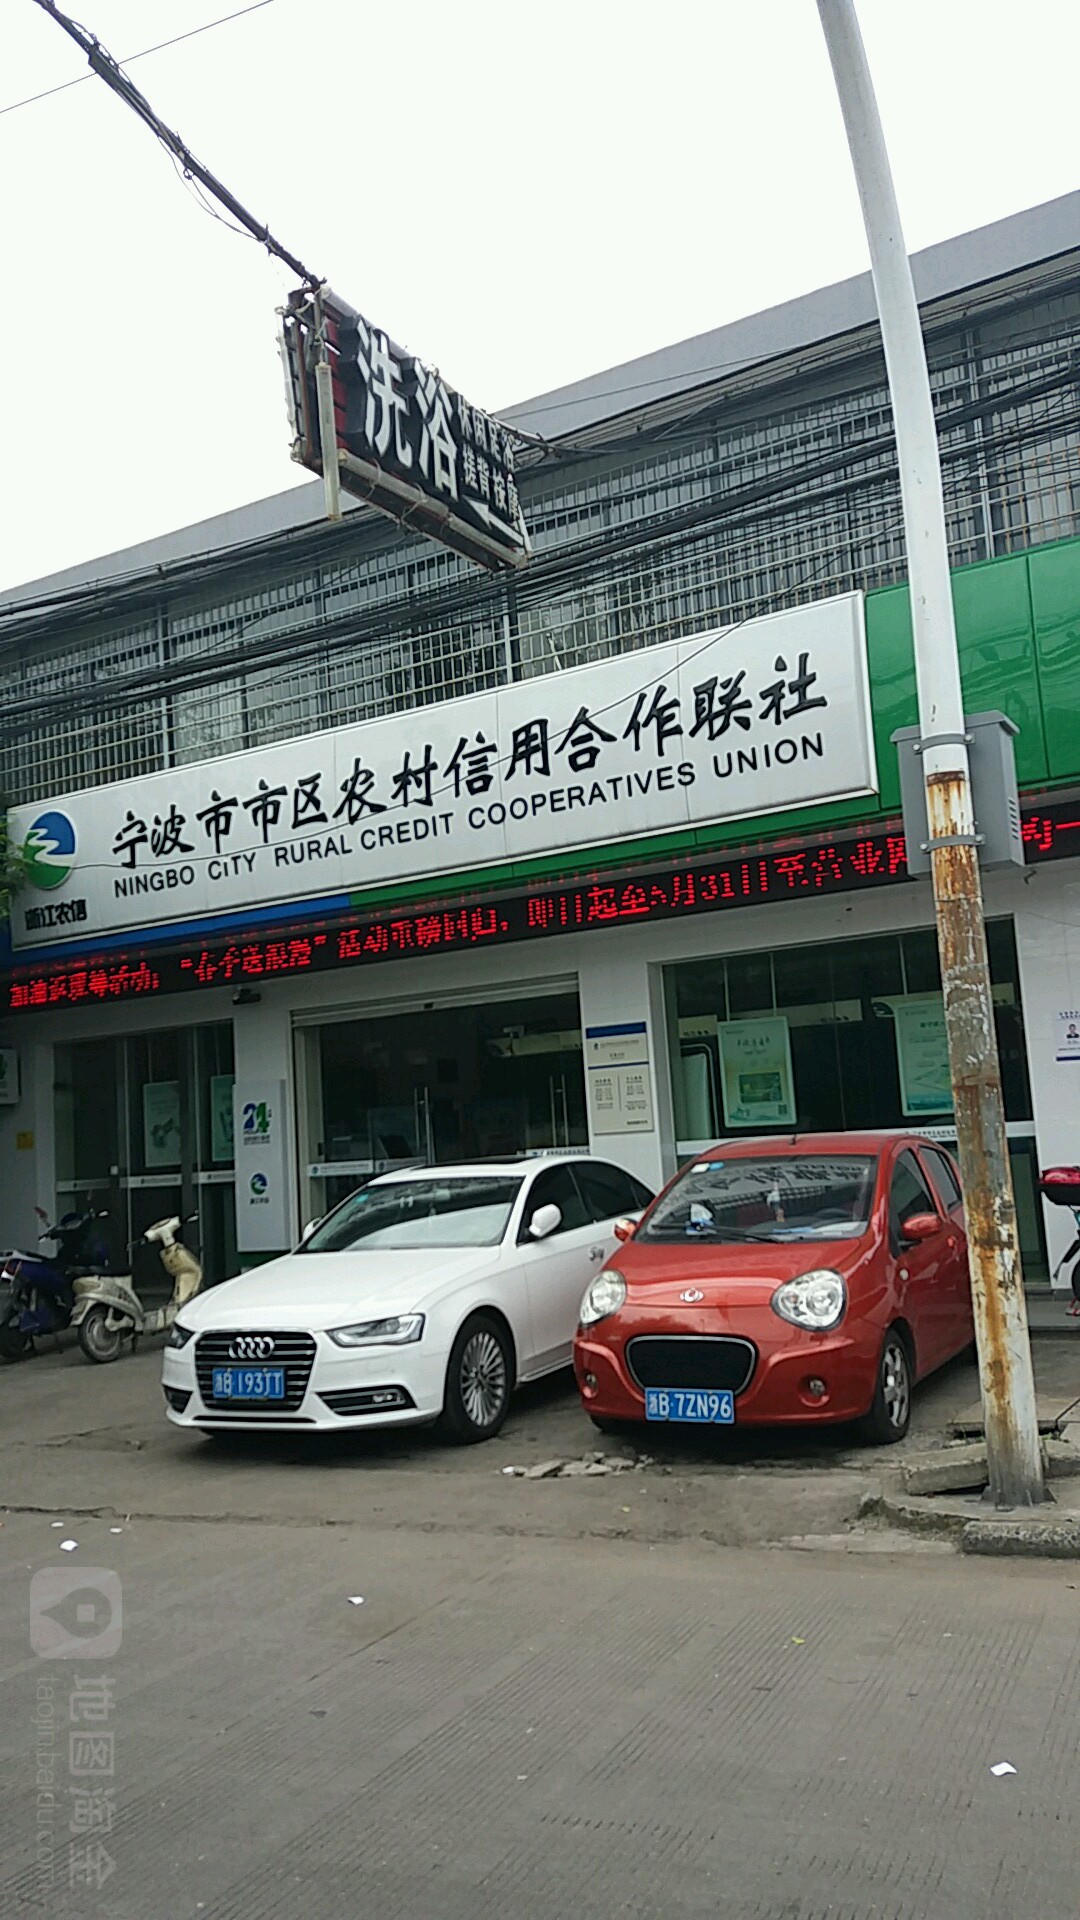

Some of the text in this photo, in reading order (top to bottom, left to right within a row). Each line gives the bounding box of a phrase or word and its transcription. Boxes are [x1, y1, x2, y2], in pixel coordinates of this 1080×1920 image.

[356, 318, 459, 501] 洗浴
[113, 652, 828, 869] 宁波市市区农村信用合作联社
[114, 865, 195, 898] NINGBO
[275, 833, 352, 867] RURAL
[360, 812, 454, 850] CREDIT
[468, 761, 696, 829] COOPERATIVES
[713, 732, 824, 779] UNION
